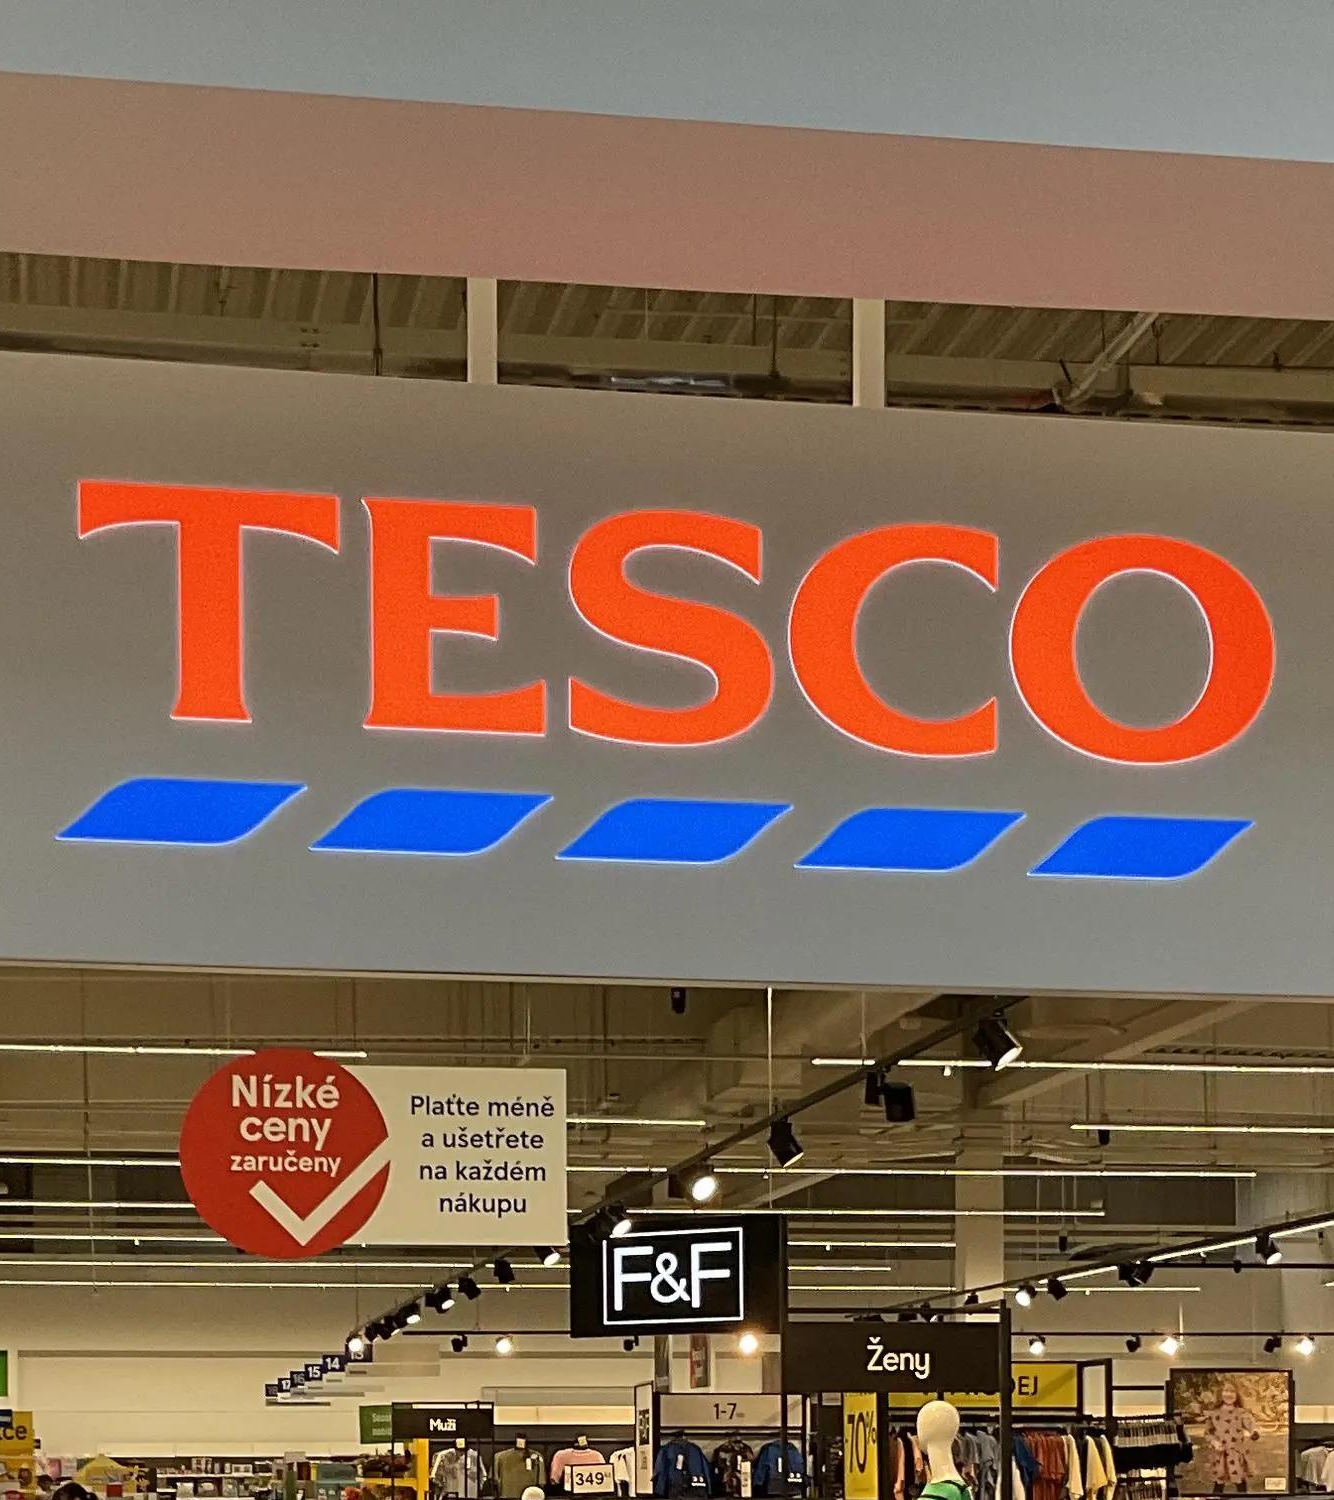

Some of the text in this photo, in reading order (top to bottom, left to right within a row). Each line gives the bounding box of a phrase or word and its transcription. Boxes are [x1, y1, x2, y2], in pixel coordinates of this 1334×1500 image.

[77, 480, 1275, 765] TESCO
[231, 1074, 340, 1109] Nízké
[410, 1094, 554, 1117] Plaťte méně
[239, 1116, 332, 1151] ceny
[421, 1126, 544, 1149] a ušetřete
[230, 1149, 342, 1178] zaručeny
[419, 1159, 546, 1182] na každém
[439, 1192, 527, 1219] nákupu
[613, 1241, 733, 1312] F&F
[325, 1357, 341, 1370] 14
[867, 1336, 931, 1380] Ženy
[307, 1366, 321, 1379] 15
[429, 1417, 457, 1432] Muži
[575, 1472, 605, 1487] 349
